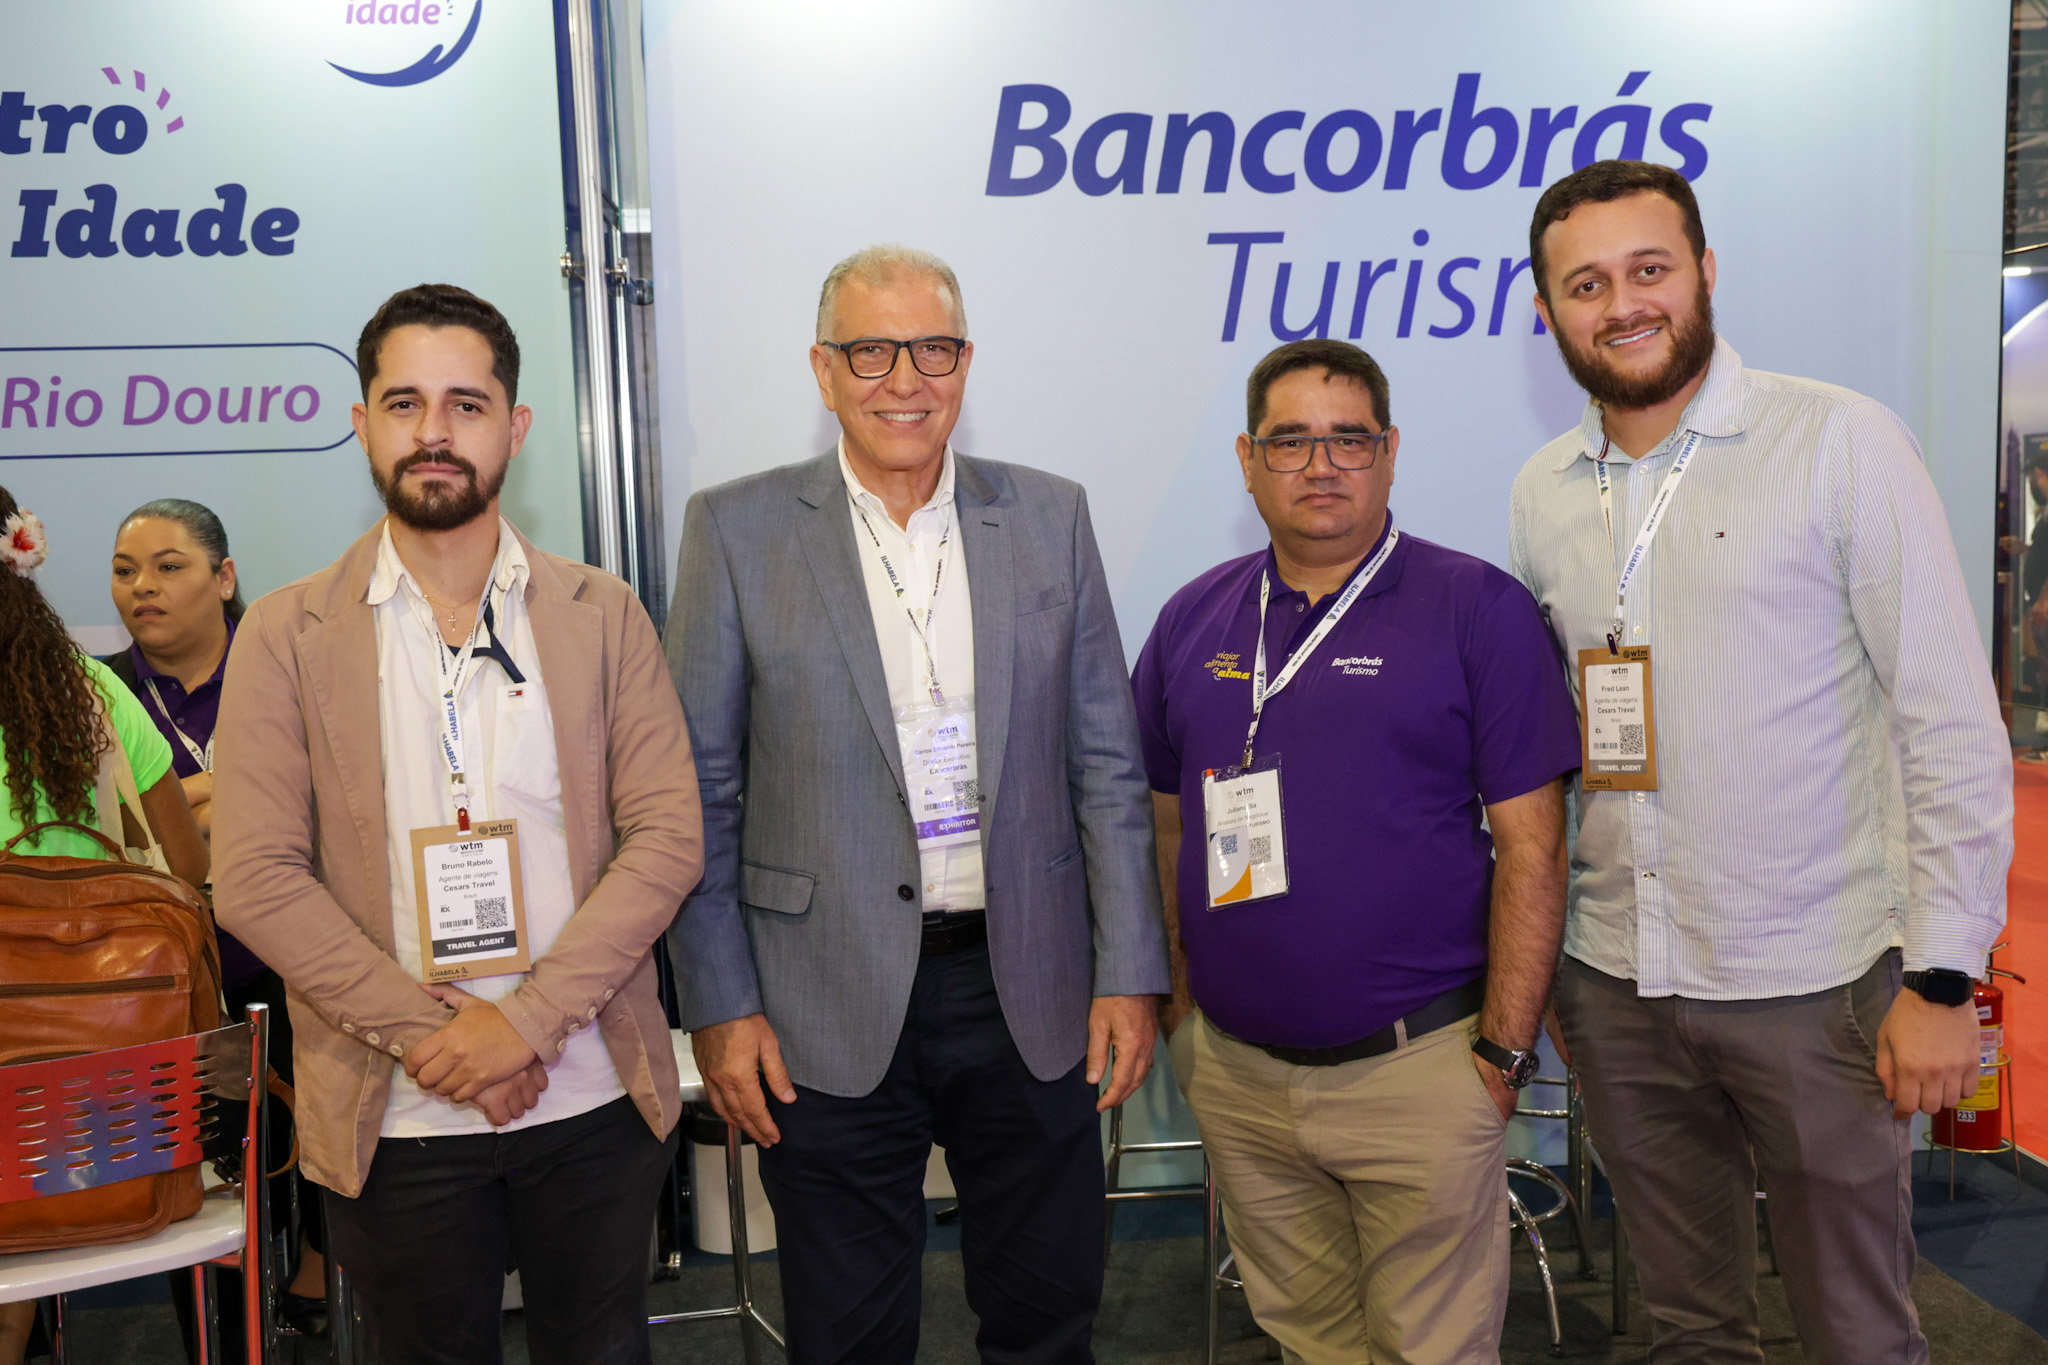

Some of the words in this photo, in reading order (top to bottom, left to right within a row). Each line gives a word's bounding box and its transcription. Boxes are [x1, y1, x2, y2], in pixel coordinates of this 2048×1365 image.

[345, 0, 441, 25] idade
[0, 91, 148, 155] tro
[985, 71, 1713, 197] Bancorbrás
[11, 183, 300, 258] Idade
[1206, 228, 1546, 342] Turis
[1, 375, 103, 428] Rio
[123, 374, 320, 426] Douro
[1677, 432, 1697, 464] HABELA
[1598, 461, 1606, 485] ABELA
[1623, 544, 1644, 580] ILHABELA
[880, 555, 900, 587] ILHABELA
[1333, 584, 1360, 612] ILHABELA
[1216, 651, 1241, 661] viajar
[1631, 649, 1648, 657] wtm
[1331, 656, 1384, 667] Bancorbrás
[1217, 668, 1251, 680] alma
[1342, 665, 1379, 676] Turismo
[1611, 666, 1628, 675] wtm
[1257, 679, 1265, 701] ABELA
[447, 700, 458, 740] ILHABELA
[937, 726, 958, 735] wtm
[1236, 788, 1254, 796] wtm
[489, 824, 513, 832] wtm
[939, 818, 976, 830] EXHIBITOR
[1249, 819, 1270, 828] TURISMO
[460, 842, 483, 850] wtm
[441, 862, 465, 870] Bruno
[466, 859, 493, 867] Rabelo
[438, 874, 462, 883] Agente
[443, 884, 470, 892] Cesars
[472, 880, 495, 888] Travel
[446, 941, 477, 950] TRAVEL
[478, 937, 505, 946] AGENT
[429, 969, 460, 977] ILHABELA
[1958, 1111, 1975, 1120] 233
